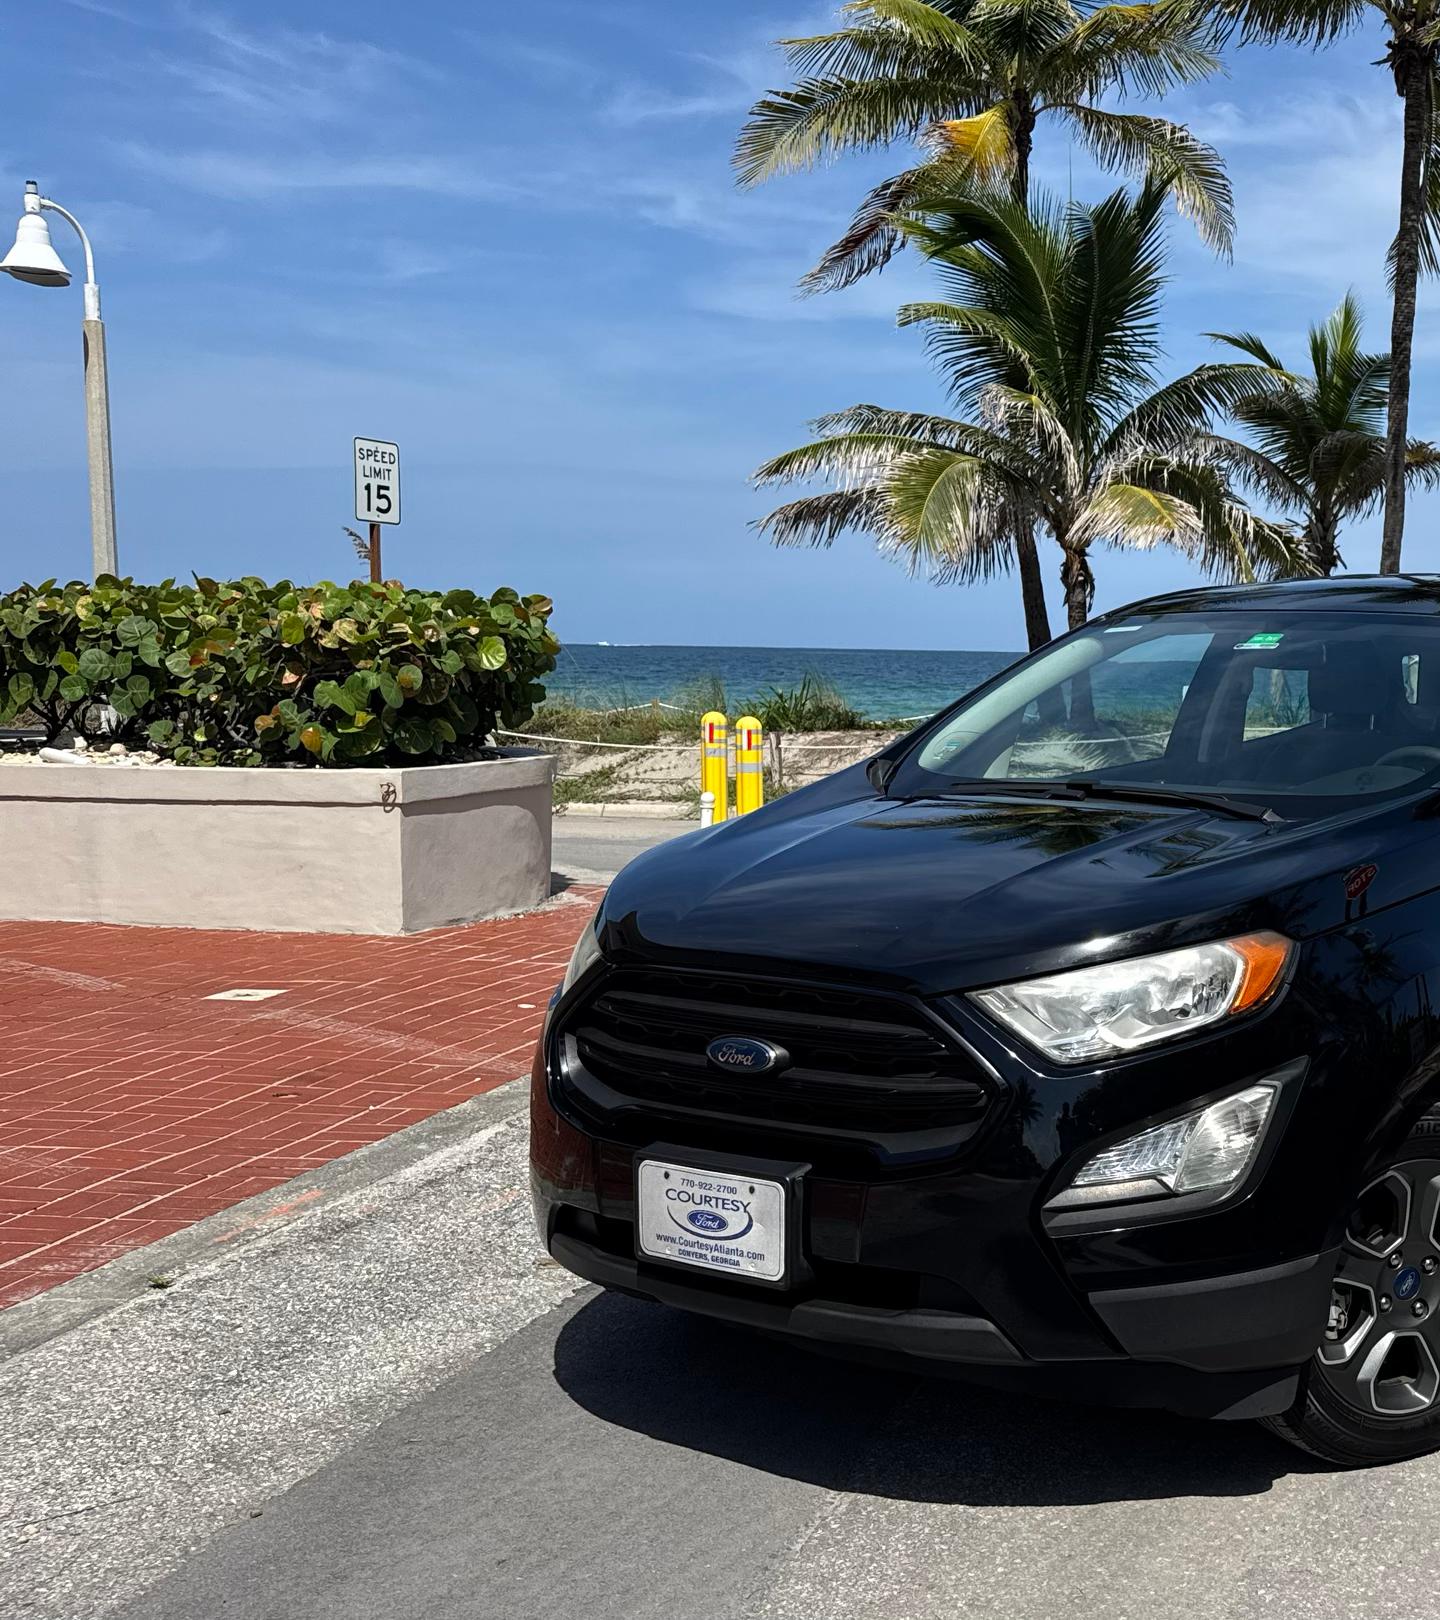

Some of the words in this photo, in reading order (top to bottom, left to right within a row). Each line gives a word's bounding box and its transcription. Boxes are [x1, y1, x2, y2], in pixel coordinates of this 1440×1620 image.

[358, 448, 396, 465] SPEED
[363, 465, 392, 481] LIMIT
[364, 483, 392, 514] 15
[718, 1043, 756, 1066] Ford
[680, 1178, 738, 1195] 770-922-2700
[665, 1188, 752, 1214] COURTESY
[695, 1213, 720, 1229] Ford
[656, 1232, 765, 1262] www.CourtesyAtlanta.com
[678, 1248, 710, 1262] CONYERS,
[711, 1255, 741, 1267] GEORGIA
